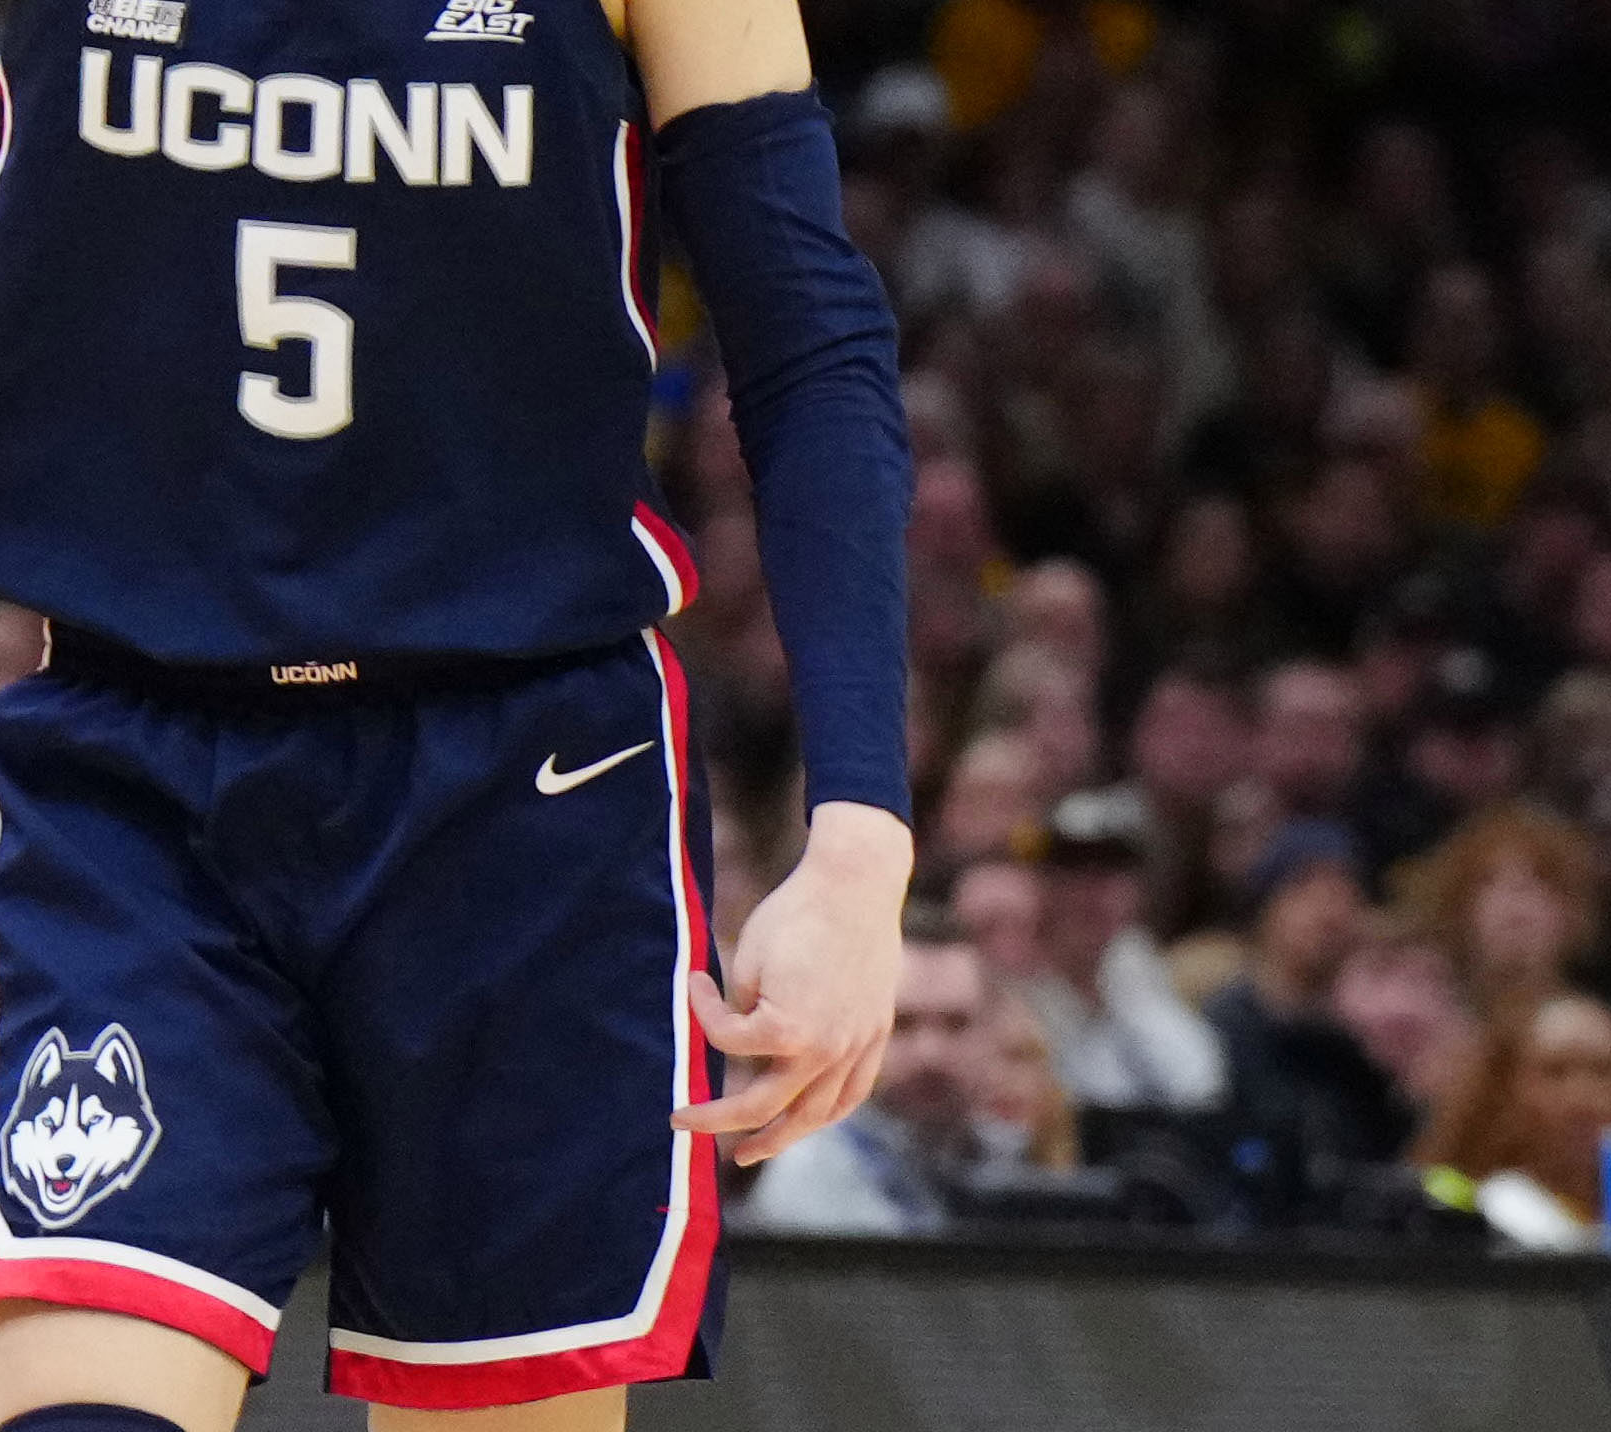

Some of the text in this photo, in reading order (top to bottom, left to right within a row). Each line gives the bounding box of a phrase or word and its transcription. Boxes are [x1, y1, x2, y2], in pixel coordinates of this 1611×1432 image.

[434, 10, 535, 36] EAST
[78, 46, 535, 189] UCONN
[235, 219, 358, 441] 5
[270, 660, 358, 685] UCONN
